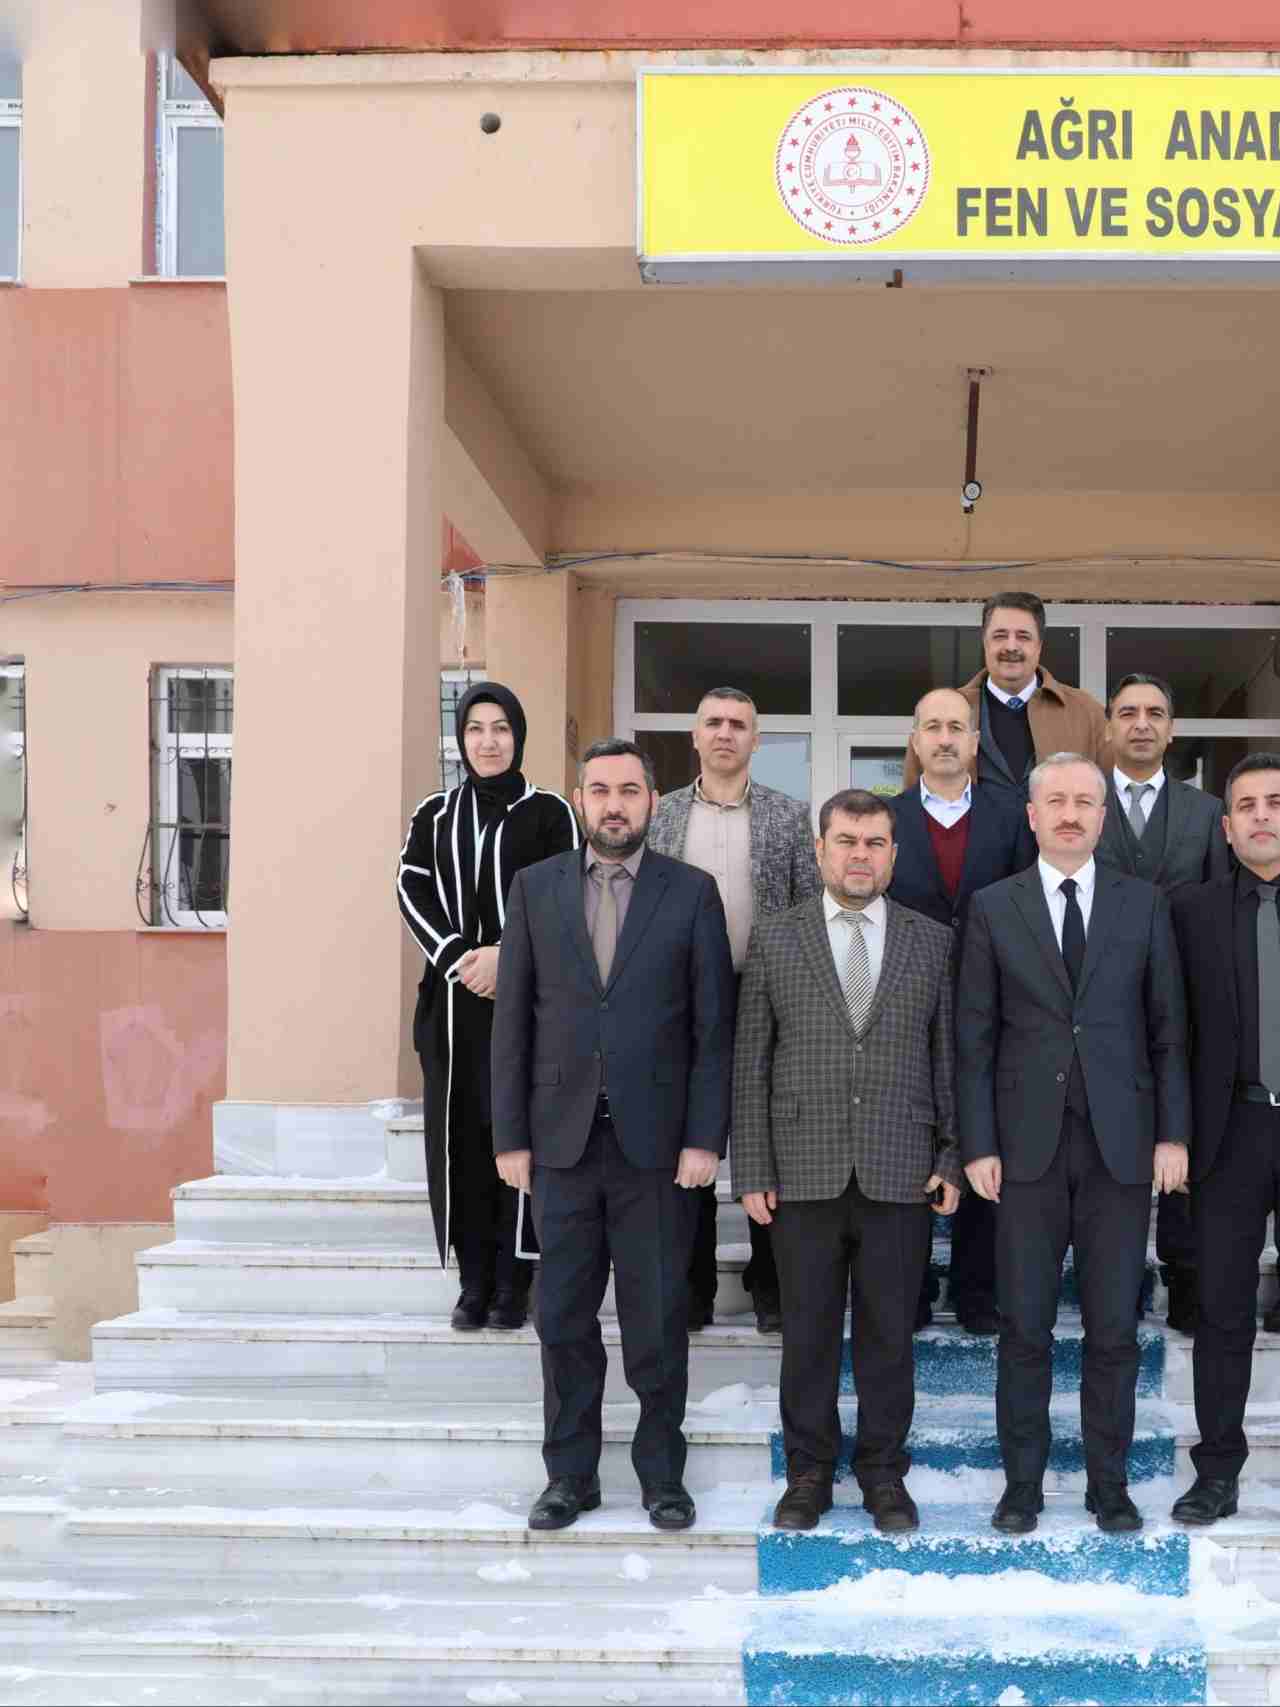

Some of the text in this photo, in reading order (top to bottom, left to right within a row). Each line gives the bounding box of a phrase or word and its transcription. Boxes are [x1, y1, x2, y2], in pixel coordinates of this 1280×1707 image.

[1016, 97, 1133, 161] AĞRI
[957, 186, 1049, 237] FEN
[1064, 186, 1129, 238] VE
